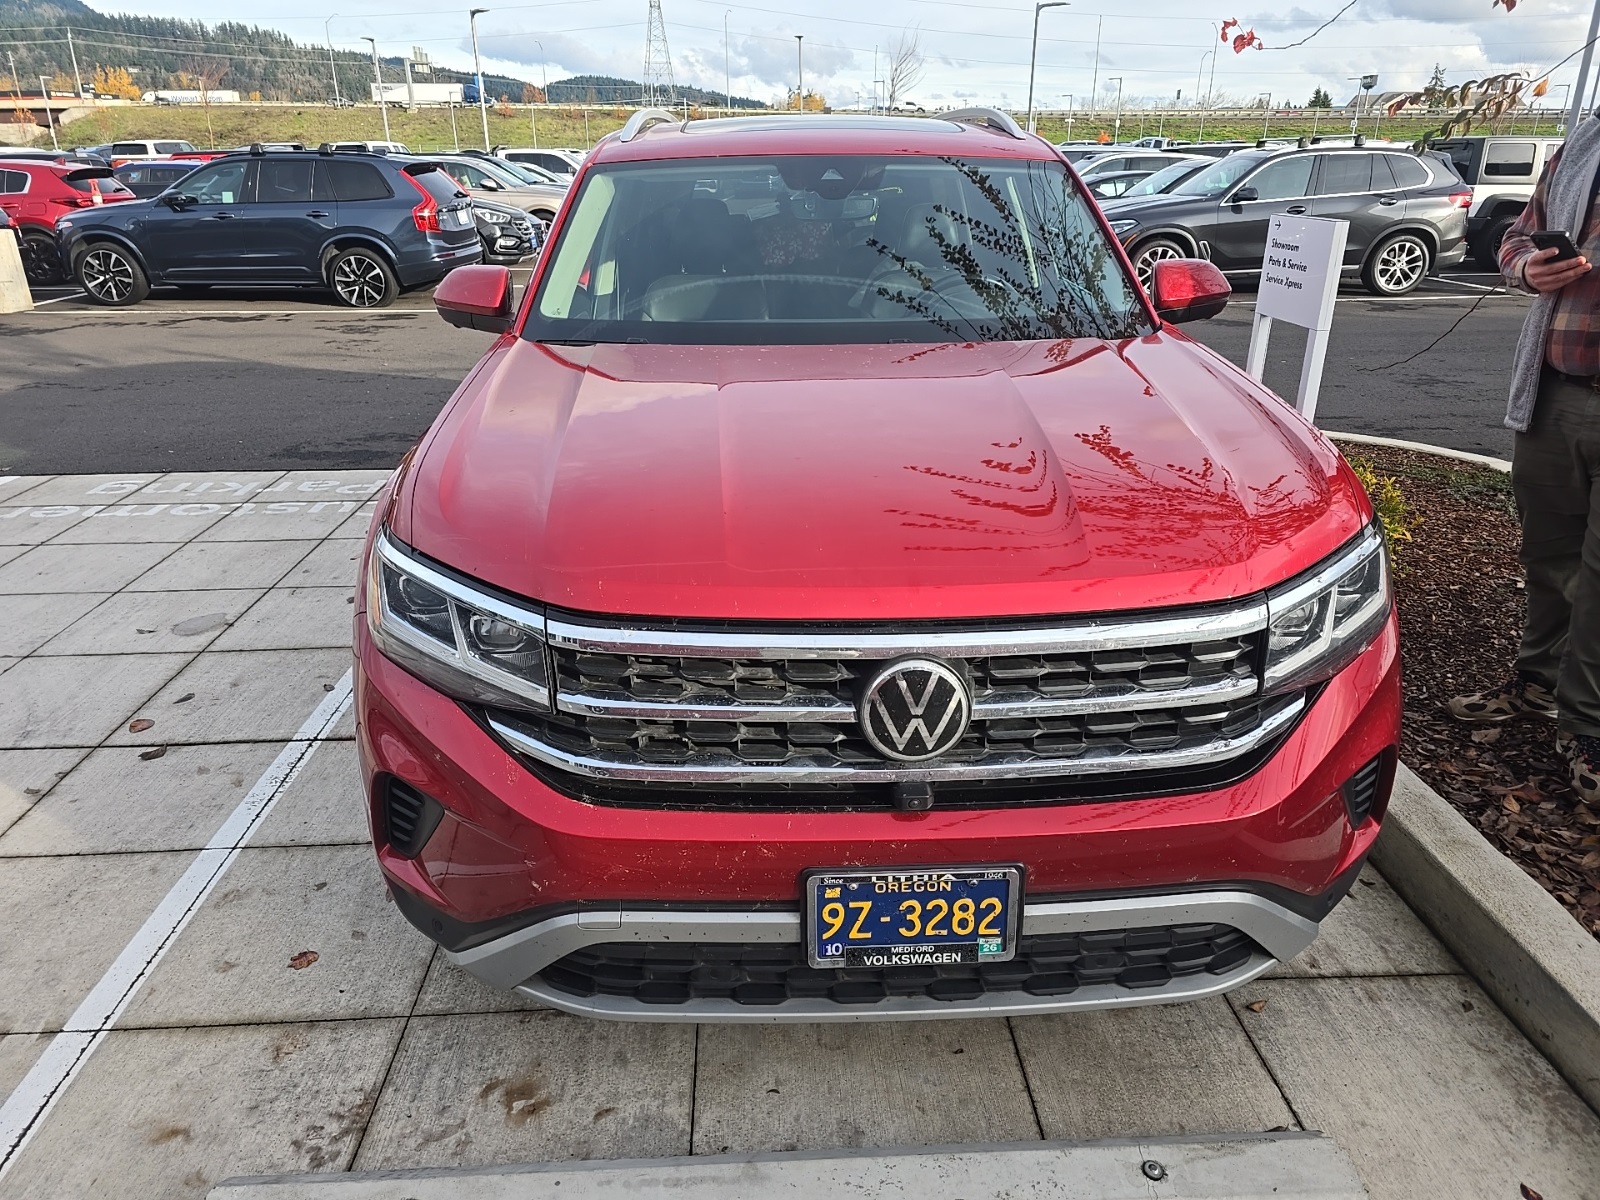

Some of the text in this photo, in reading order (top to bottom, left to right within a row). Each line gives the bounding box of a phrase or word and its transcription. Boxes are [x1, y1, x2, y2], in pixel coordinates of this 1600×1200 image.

[1271, 238, 1300, 252] Showroom
[1268, 255, 1308, 273] Parts & Service
[1265, 272, 1303, 290] Service Xpress
[823, 872, 1003, 885] Since LITHIA 1946
[874, 881, 952, 894] OREGON
[825, 943, 842, 956] 10
[891, 945, 935, 953] MEDFORD
[983, 943, 998, 952] 26
[863, 953, 962, 966] VOLKSWAGEN
